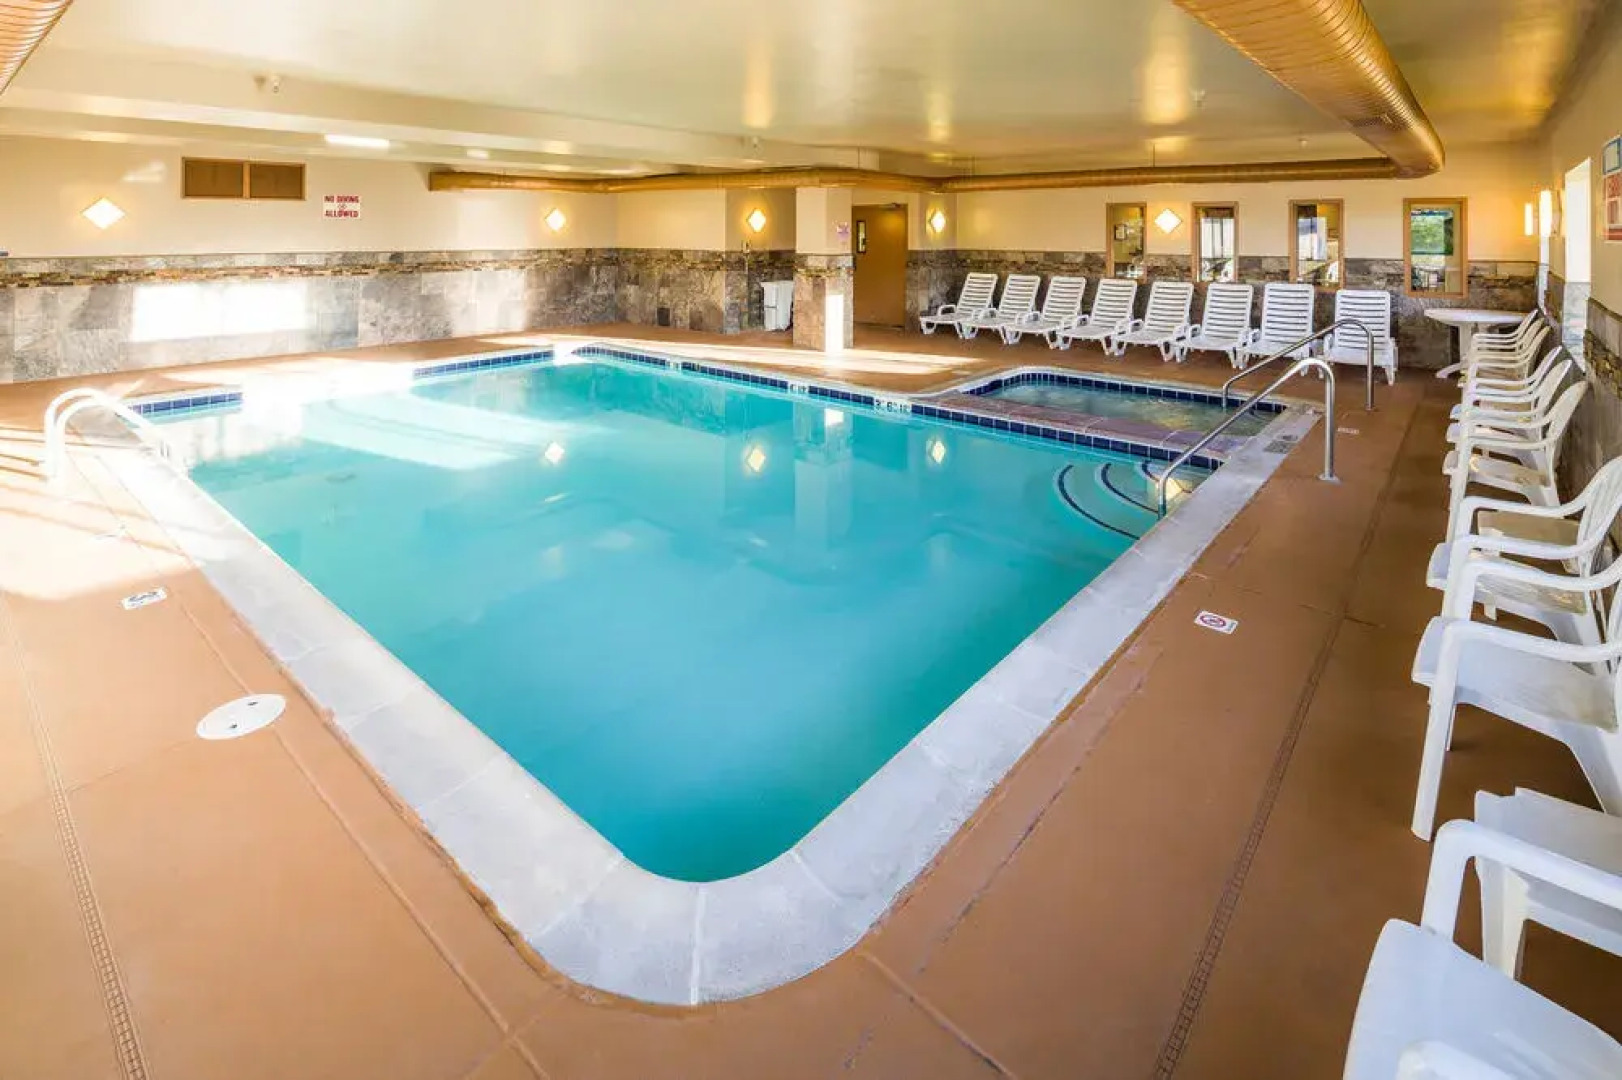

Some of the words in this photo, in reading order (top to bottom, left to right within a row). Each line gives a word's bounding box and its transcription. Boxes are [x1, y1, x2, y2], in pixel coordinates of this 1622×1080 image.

[324, 195, 335, 203] NO
[336, 195, 359, 203] DIVING
[324, 210, 359, 218] ALLOWED
